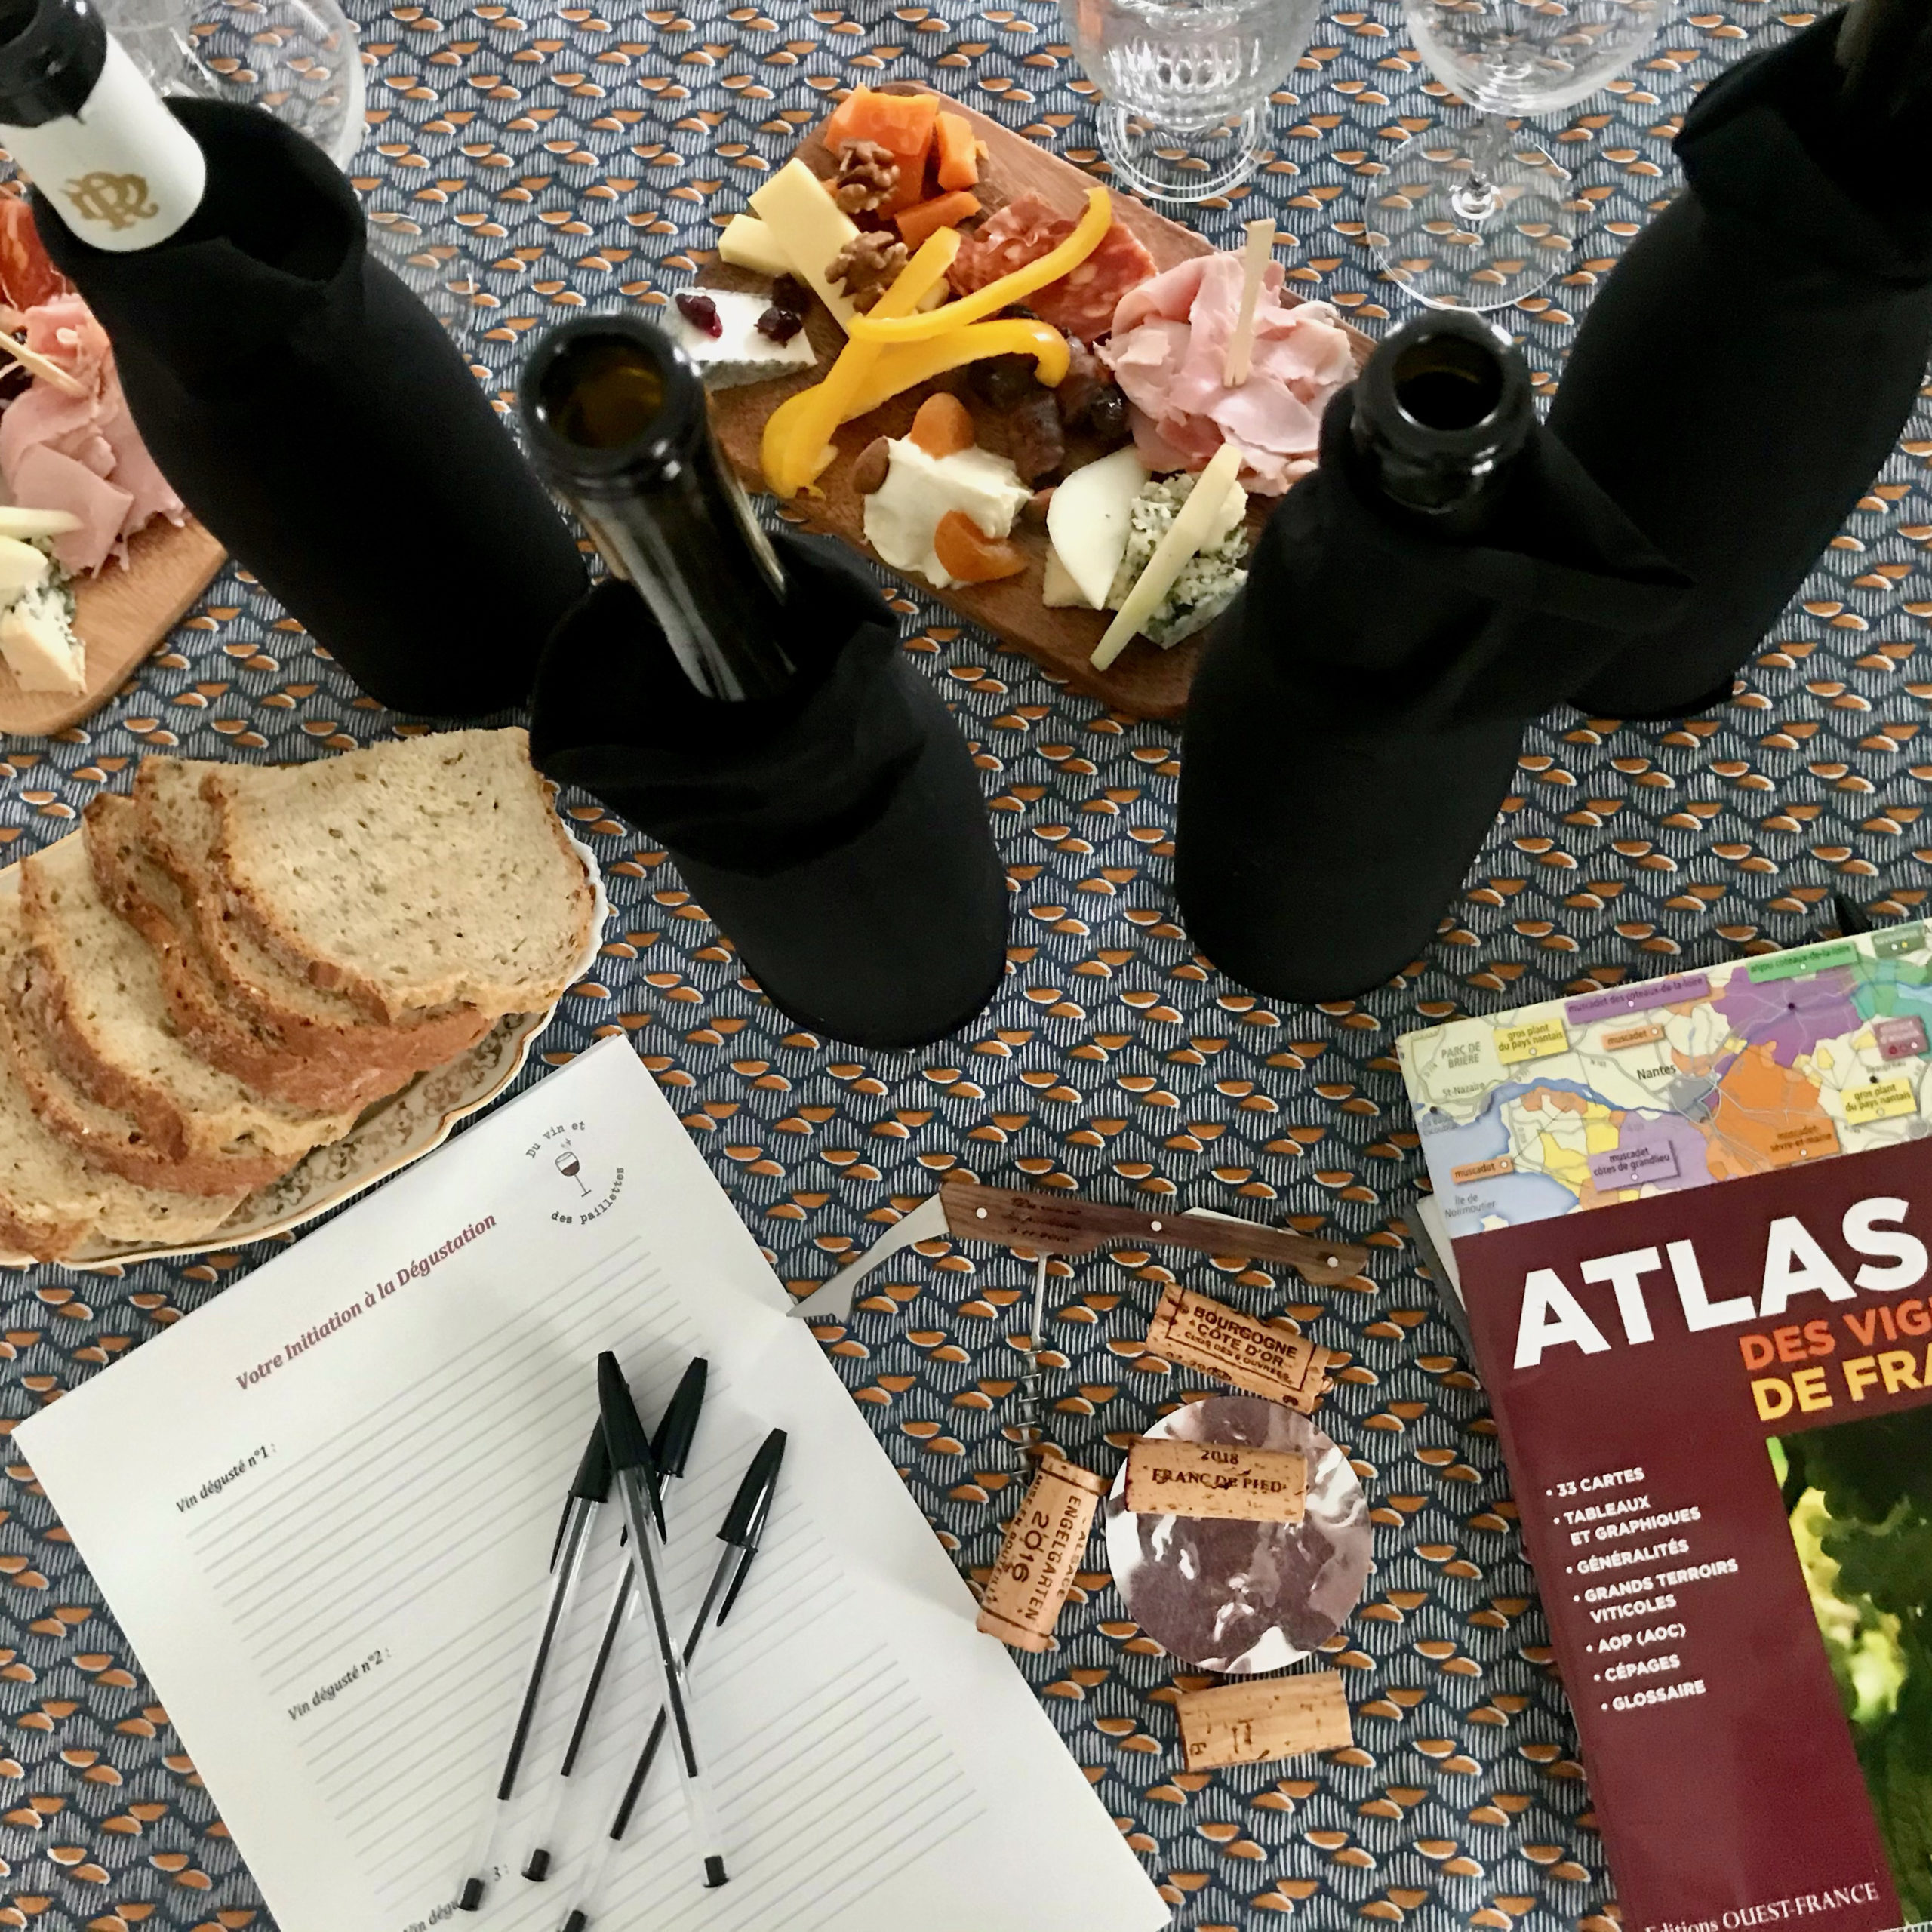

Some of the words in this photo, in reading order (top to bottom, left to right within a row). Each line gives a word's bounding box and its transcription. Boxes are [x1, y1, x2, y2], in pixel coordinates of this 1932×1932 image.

[1569, 997, 1607, 1012] muscadet
[1611, 995, 1623, 1004] des
[1499, 1043, 1509, 1051] du
[1512, 1040, 1531, 1051] pays
[1533, 1032, 1563, 1044] nantais
[1507, 1031, 1525, 1041] gros
[1527, 1024, 1549, 1037] plant
[1607, 1030, 1647, 1044] muscadet
[1441, 1044, 1465, 1059] PARC
[1469, 1041, 1481, 1052] DE
[1637, 1065, 1676, 1080] Nantes
[1845, 1103, 1857, 1112] du
[1859, 1100, 1878, 1111] pays
[1880, 1092, 1911, 1104] nantais
[1854, 1091, 1872, 1100] gros
[1874, 1084, 1896, 1097] plant
[526, 1143, 541, 1158] Du
[543, 1124, 565, 1140] vin
[571, 1121, 585, 1131] et
[1609, 1147, 1649, 1163] muscadet
[1618, 1161, 1628, 1171] de
[1630, 1154, 1670, 1170] grandlieu
[1455, 1163, 1496, 1178] muscadet
[552, 1211, 572, 1223] des
[580, 1168, 624, 1224] paillettes
[1445, 1201, 1496, 1217] Noirmoutier
[1467, 1194, 1478, 1203] de
[1514, 1197, 1929, 1369] ATLAS
[236, 1354, 283, 1390] Votre
[284, 1303, 363, 1361] Initiation
[365, 1291, 376, 1307] à
[377, 1281, 395, 1299] la
[396, 1215, 496, 1287] Dégustation
[1185, 1331, 1211, 1349] CLOS
[1214, 1344, 1232, 1356] DES
[1194, 1306, 1298, 1359] BOURGOGNE
[1739, 1319, 1835, 1370] DES
[1843, 1297, 1932, 1346] VIG
[1245, 1344, 1284, 1367] D'OR
[1751, 1366, 1833, 1421] DE
[1201, 1449, 1238, 1465] 2018
[176, 1495, 198, 1512] Vin
[200, 1459, 245, 1499] dégusté
[1026, 1475, 1043, 1508] MISE
[1152, 1469, 1211, 1484] FRANC
[1215, 1475, 1238, 1487] DE
[1243, 1478, 1281, 1492] PIED
[1557, 1481, 1577, 1497] 33
[1580, 1467, 1644, 1492] CARTES
[1014, 1509, 1026, 1525] EN
[1563, 1495, 1651, 1525] TABLEAUX
[1571, 1529, 1589, 1546] ET
[1595, 1506, 1701, 1540] GRAPHIQUES
[1012, 1510, 1048, 1583] 2016
[1025, 1495, 1081, 1620] ENGELGARTEN
[1577, 1538, 1689, 1574] GÉNÉRALITÉS
[1057, 1529, 1086, 1597] ALSACE
[1584, 1577, 1654, 1602] GRANDS
[1656, 1558, 1738, 1587] TERROIRS
[1590, 1594, 1677, 1623] VITICOLES
[1598, 1634, 1632, 1653] AOP
[1636, 1623, 1686, 1646] (AOC)
[1604, 1654, 1680, 1681] CÉPAGES
[288, 1703, 310, 1720] Vin
[312, 1664, 358, 1706] dégusté
[1612, 1679, 1706, 1711] GLOSSAIRE
[1722, 1881, 1879, 1929] OUEST-FRANCE
